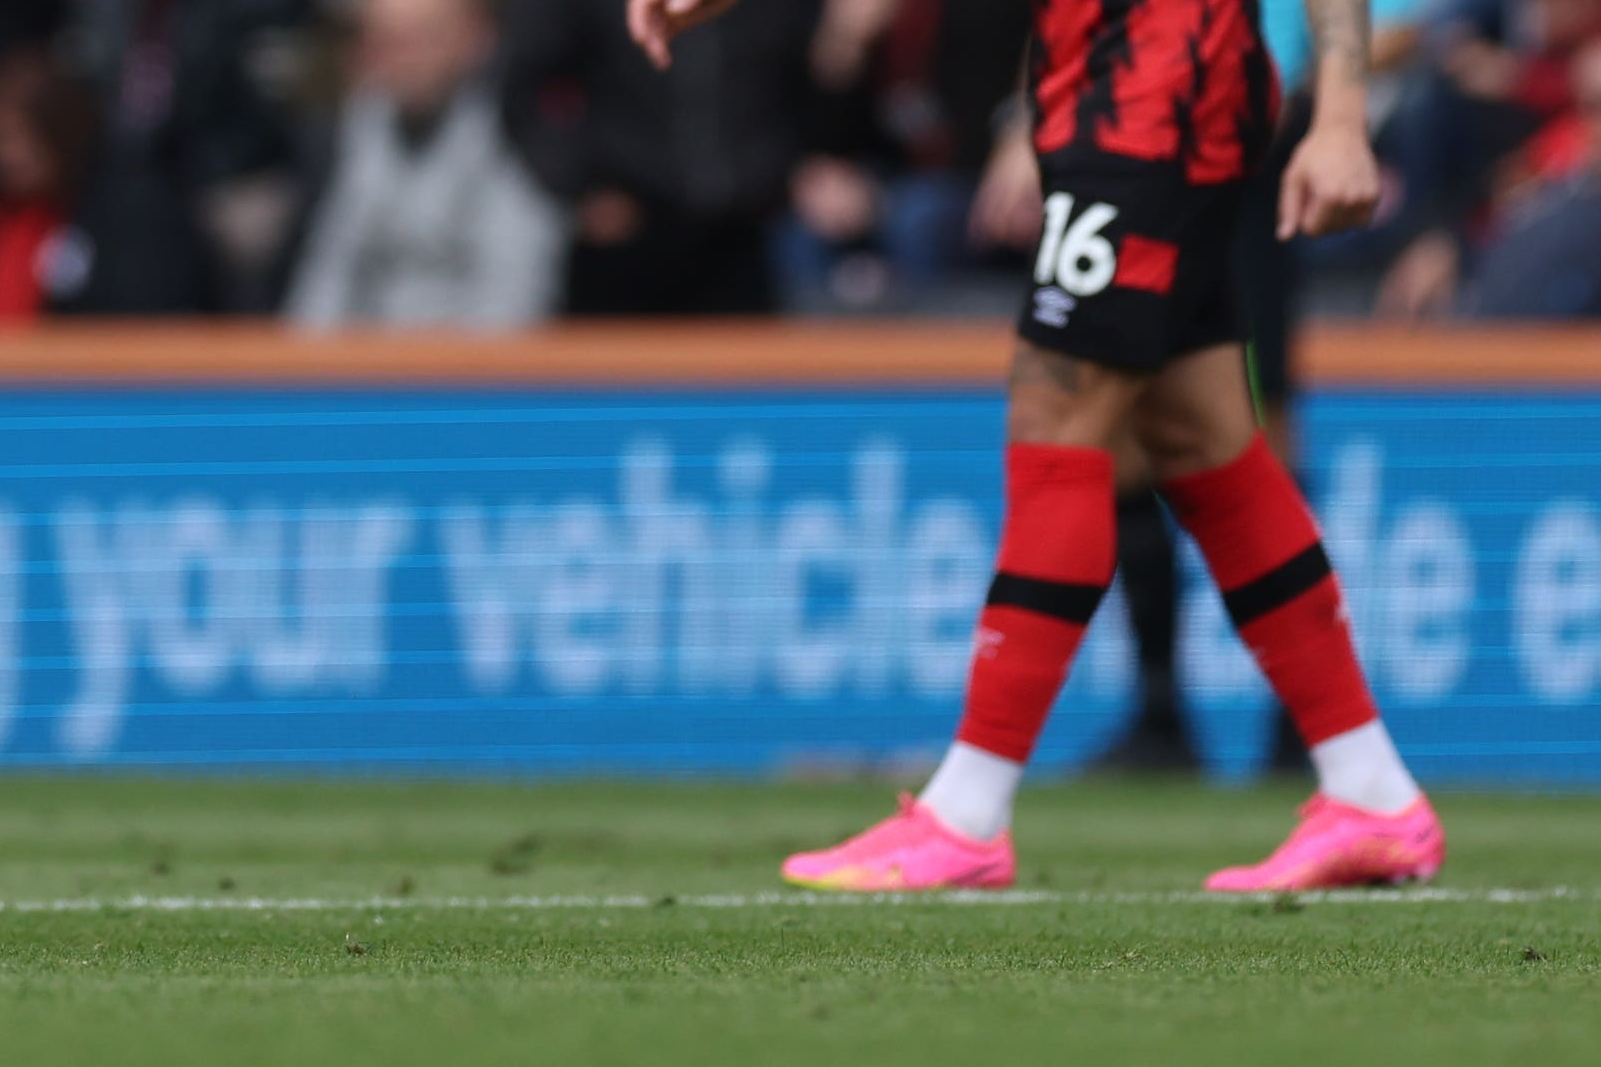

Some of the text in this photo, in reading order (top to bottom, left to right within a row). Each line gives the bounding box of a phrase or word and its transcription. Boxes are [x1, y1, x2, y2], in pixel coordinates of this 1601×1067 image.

[1033, 191, 1119, 297] 16
[53, 489, 413, 759] your
[439, 432, 995, 699] vehicle
